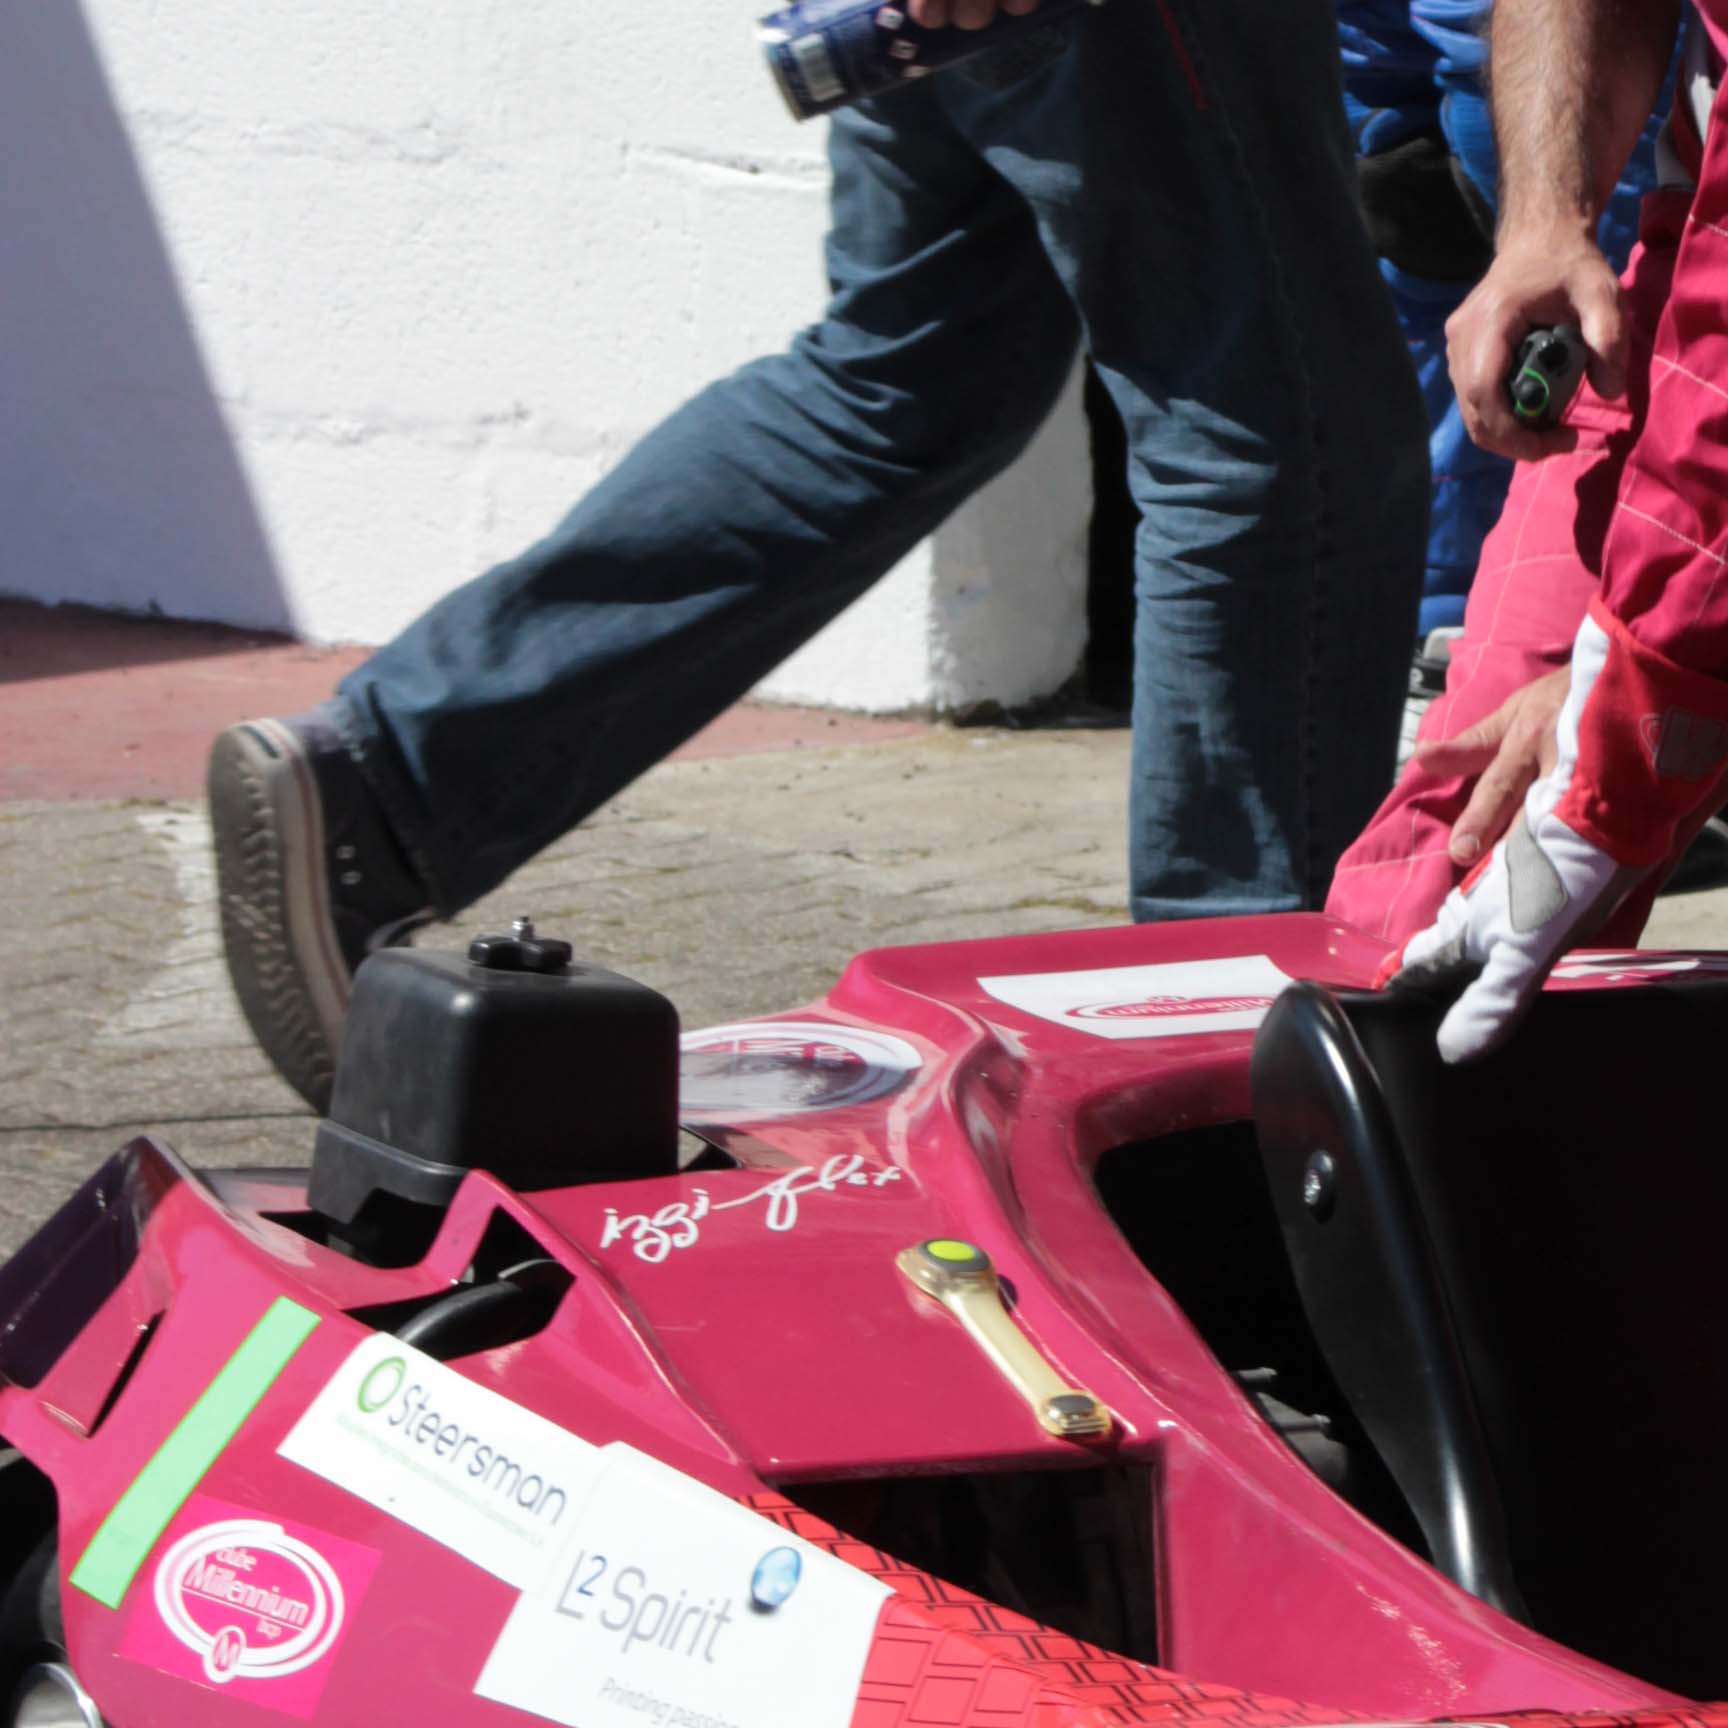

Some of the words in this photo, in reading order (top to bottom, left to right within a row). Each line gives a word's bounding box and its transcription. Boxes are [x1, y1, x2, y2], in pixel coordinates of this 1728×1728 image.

[387, 1384, 568, 1526] Steersman
[184, 1553, 310, 1626] Millennium
[600, 1566, 733, 1664] Spirit
